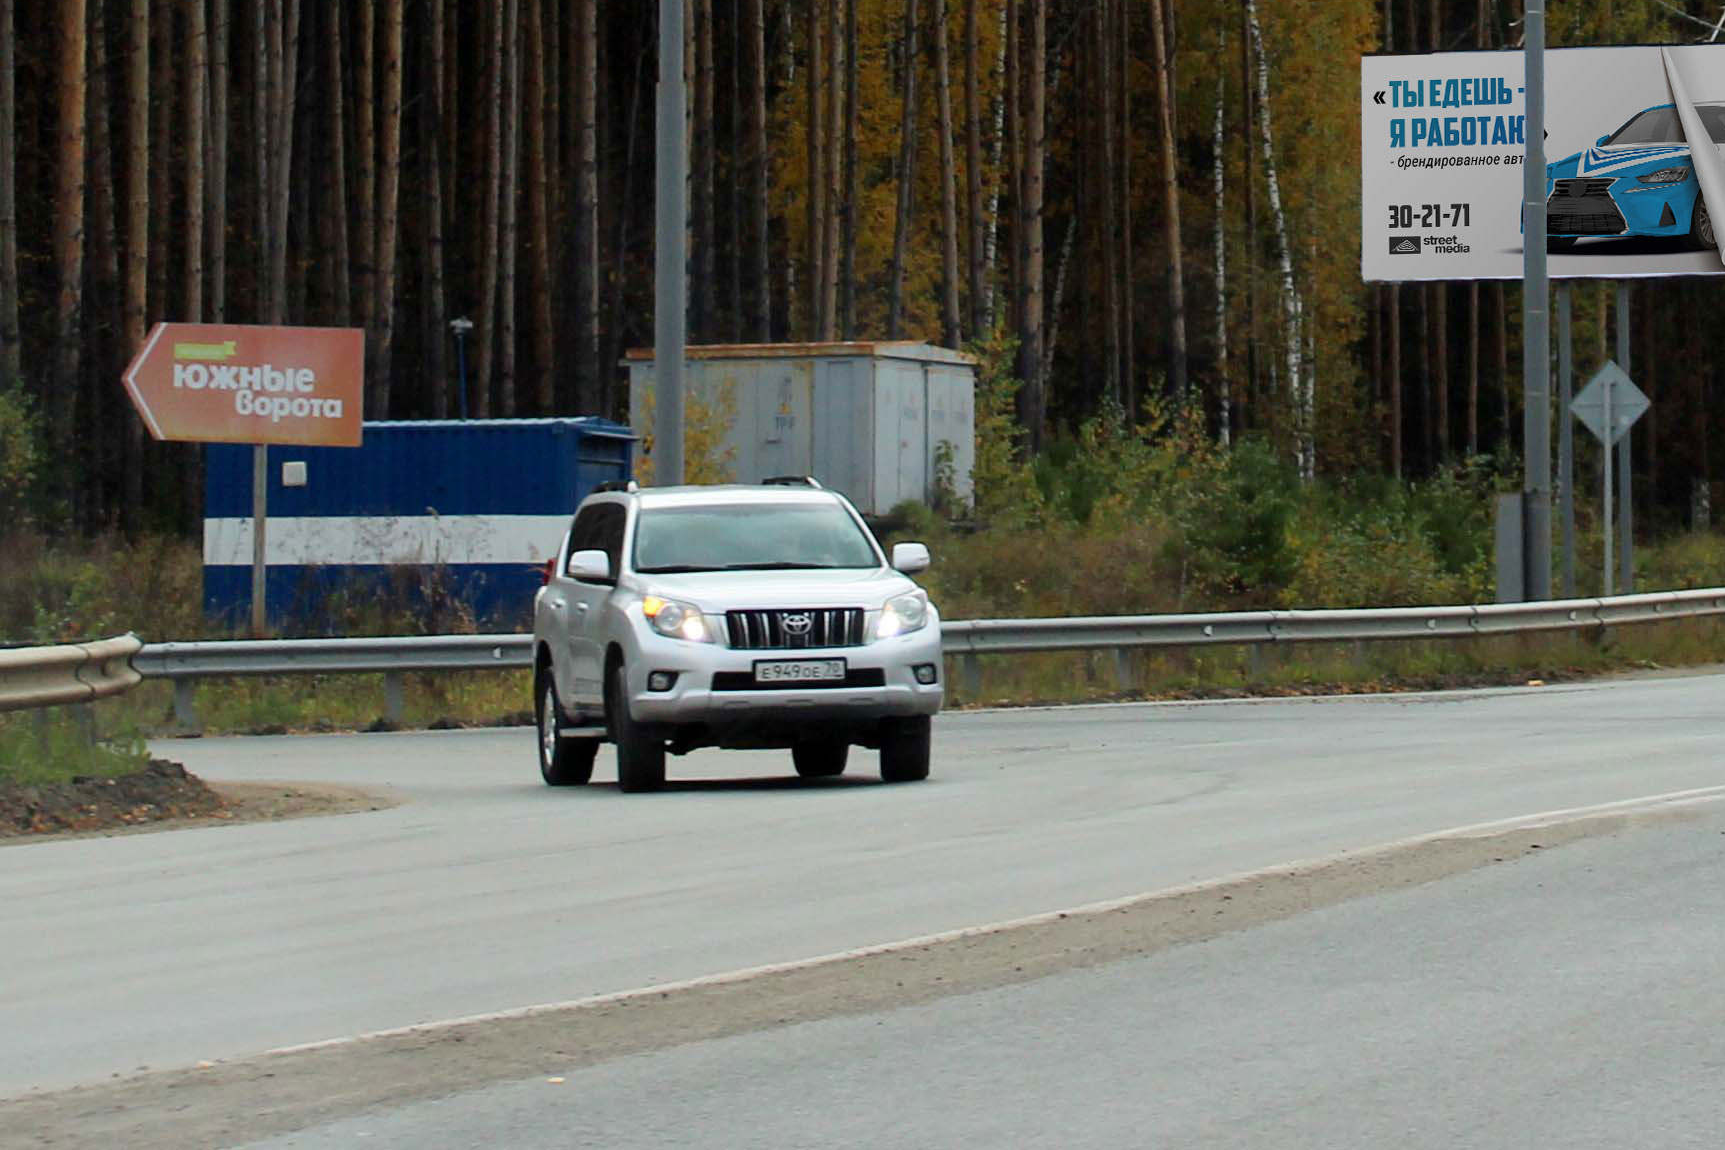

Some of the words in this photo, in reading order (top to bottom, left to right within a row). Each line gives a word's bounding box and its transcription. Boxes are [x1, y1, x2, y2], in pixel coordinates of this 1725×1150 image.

[1429, 77, 1513, 108] ЕДЕШЬ
[1390, 118, 1406, 148] Я
[1397, 154, 1501, 170] брендированное
[1503, 155, 1525, 165] авт
[1388, 203, 1470, 229] 30-21-71
[1423, 235, 1458, 246] street
[1434, 244, 1471, 254] media
[235, 389, 343, 423] ворота
